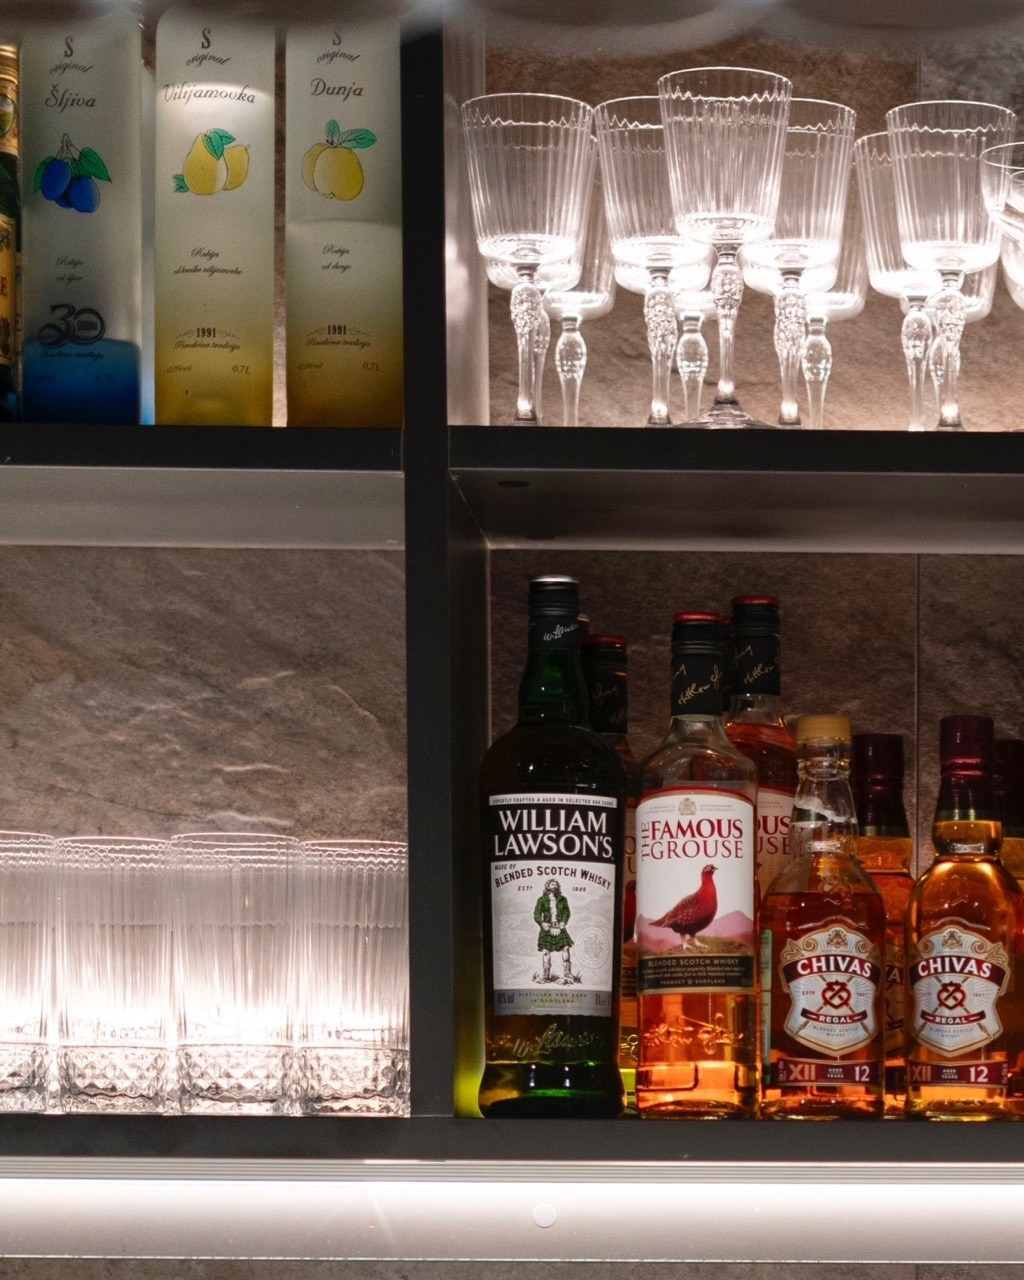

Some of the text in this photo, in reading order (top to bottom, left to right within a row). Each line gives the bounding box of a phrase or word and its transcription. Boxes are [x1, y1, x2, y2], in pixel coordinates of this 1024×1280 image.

[45, 83, 97, 113] Šljiva
[162, 82, 256, 105] Vilijamovka
[310, 78, 364, 101] Dunja
[196, 326, 217, 339] 1991
[327, 324, 348, 337] 1991
[498, 808, 607, 834] WILLIAM
[651, 818, 744, 841] FAMOUS
[494, 832, 613, 859] LAWSON'S
[640, 821, 651, 862] THE
[650, 839, 744, 860] GROUSE
[495, 864, 613, 891] BLENDED SCOTCH WHISKY
[647, 957, 740, 968] BLENDED SCOTCH WHISKY
[796, 955, 873, 978] CHIVAS
[917, 956, 993, 979] CHIVAS
[818, 1015, 852, 1023] REGAL
[935, 1016, 968, 1024] REGAL
[789, 1063, 816, 1081] XII
[854, 1065, 870, 1082] 12
[969, 1066, 989, 1083] 12
